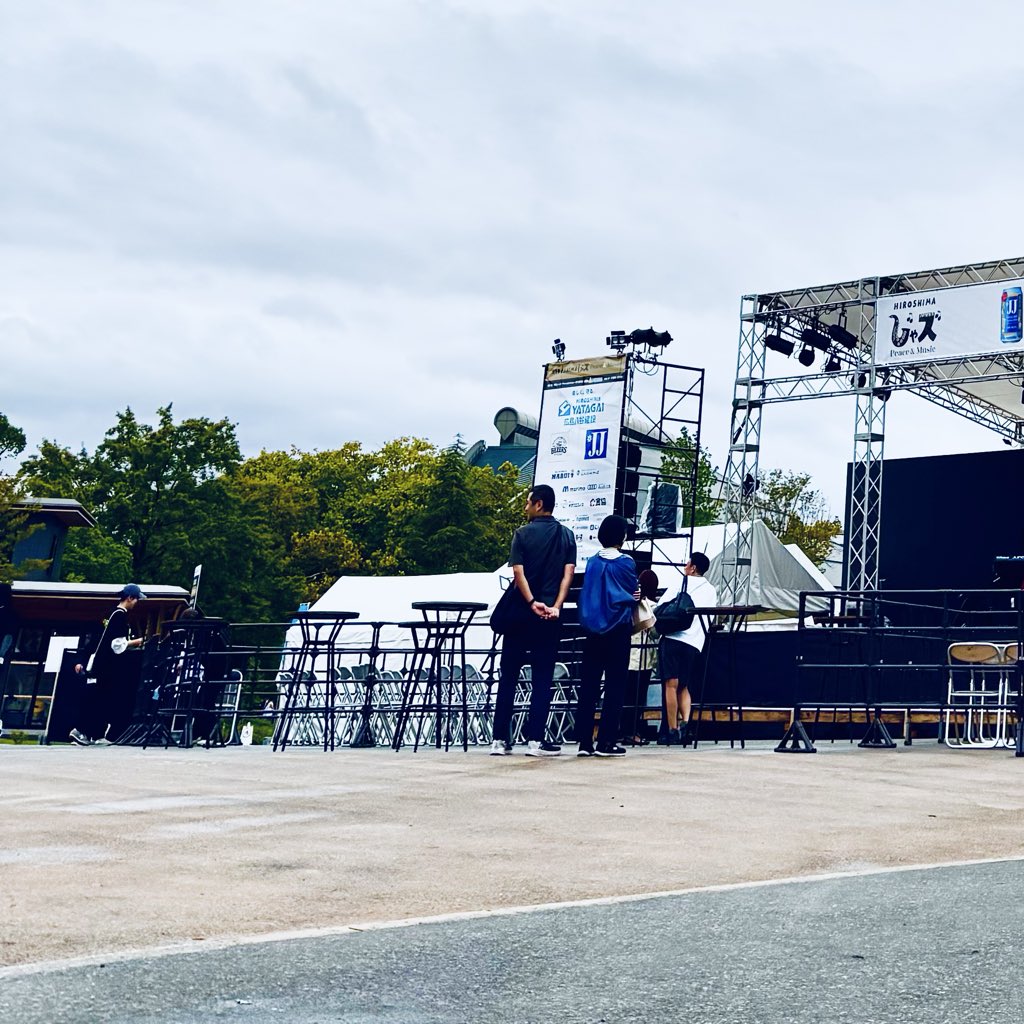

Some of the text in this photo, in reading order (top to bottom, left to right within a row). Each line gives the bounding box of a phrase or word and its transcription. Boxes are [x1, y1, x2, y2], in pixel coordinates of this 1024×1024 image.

[894, 297, 936, 310] HIROSHIMA
[889, 310, 942, 348] じゃズ
[890, 350, 910, 358] Peace
[916, 346, 936, 355] Music
[572, 402, 604, 414] YATAGAI
[588, 431, 608, 456] JJ
